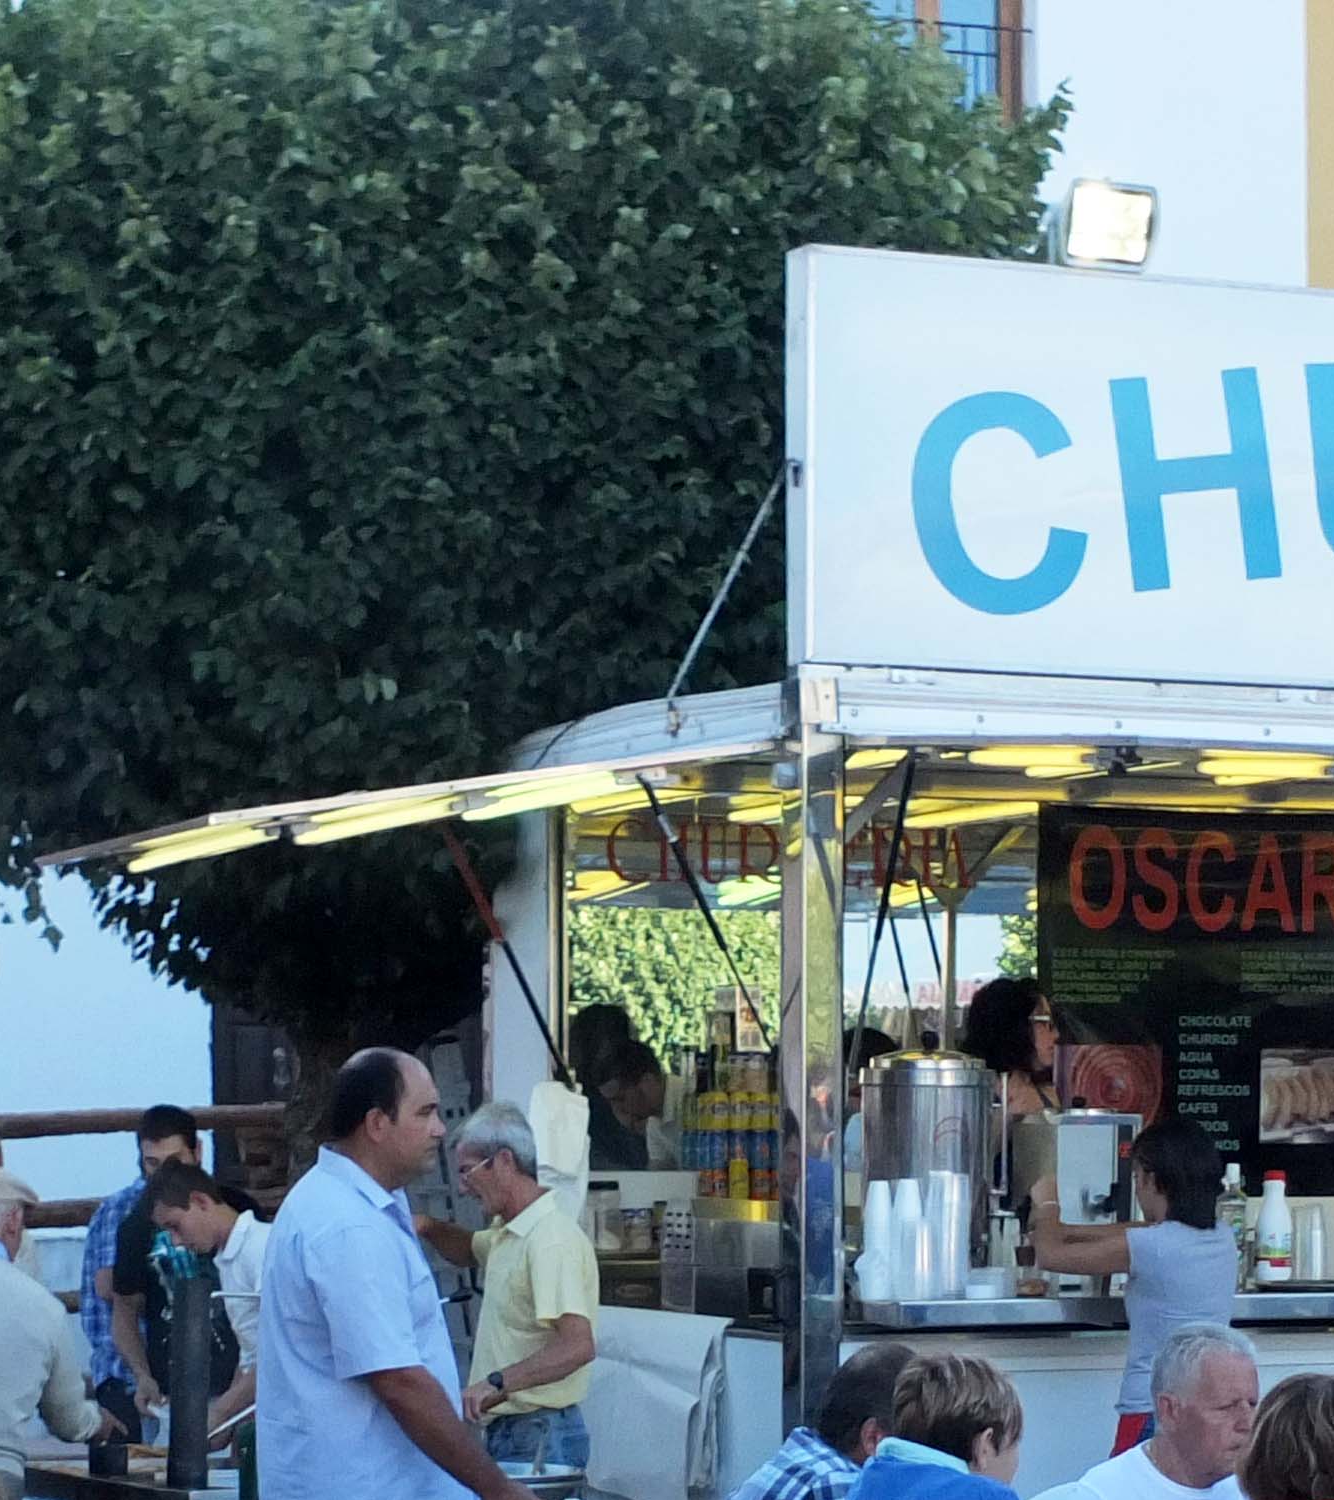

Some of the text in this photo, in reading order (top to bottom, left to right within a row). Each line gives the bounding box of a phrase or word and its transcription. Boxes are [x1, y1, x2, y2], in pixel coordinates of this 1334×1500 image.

[1178, 1015, 1252, 1028] CHOCOLATE
[1178, 1033, 1239, 1046] CHURROS
[1179, 1051, 1213, 1063] AGUA
[1178, 1068, 1220, 1080] COPAS
[1177, 1084, 1251, 1097] REFRESCOS
[1177, 1102, 1219, 1114] CAFES
